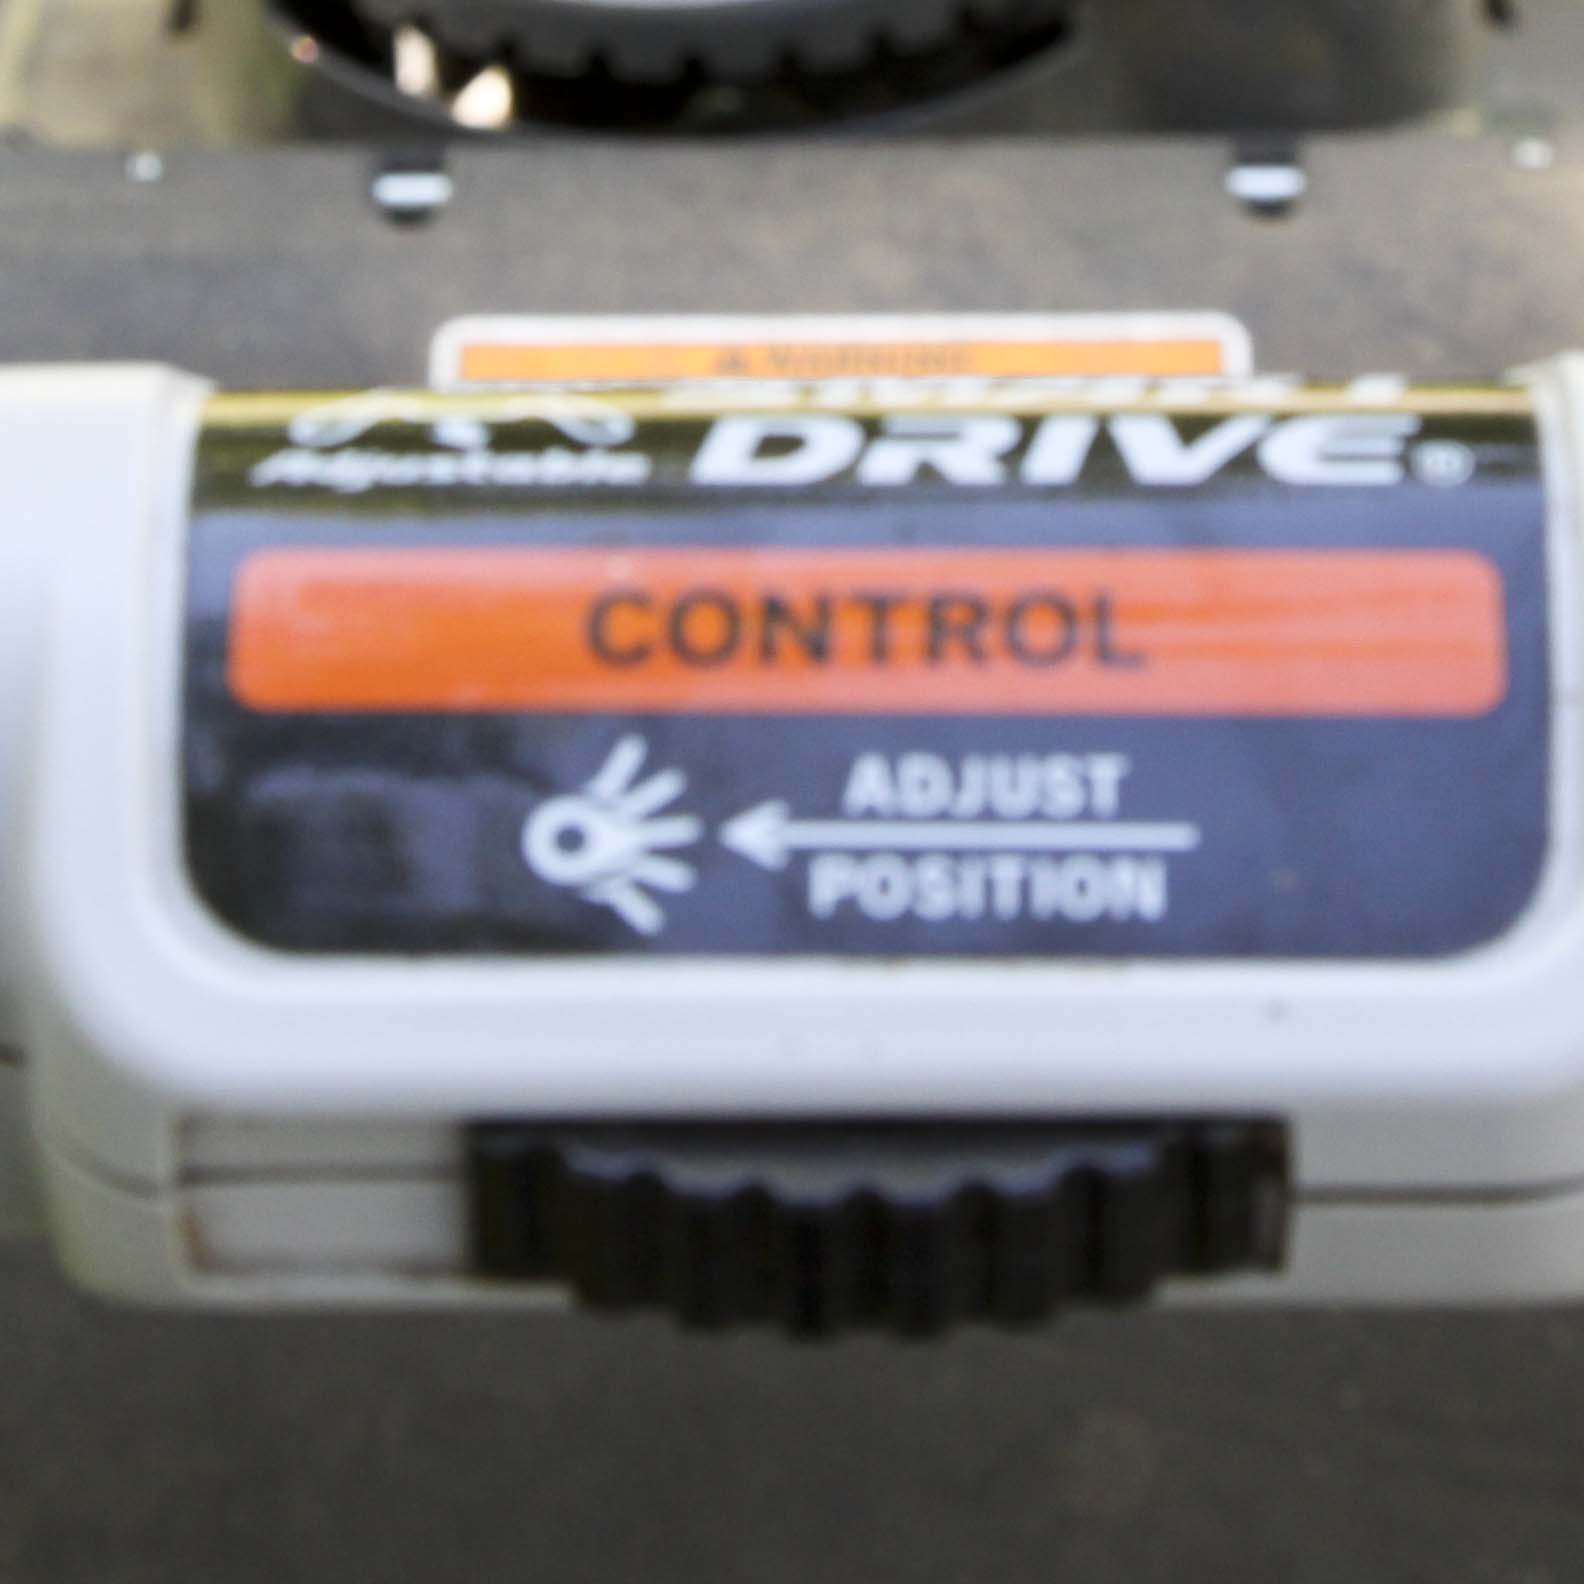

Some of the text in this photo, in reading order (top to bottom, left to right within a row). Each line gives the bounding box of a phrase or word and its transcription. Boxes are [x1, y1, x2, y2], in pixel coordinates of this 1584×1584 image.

[583, 588, 1150, 670] CONTROL
[840, 750, 1132, 818] ADJUST
[806, 852, 1169, 920] POSITION
